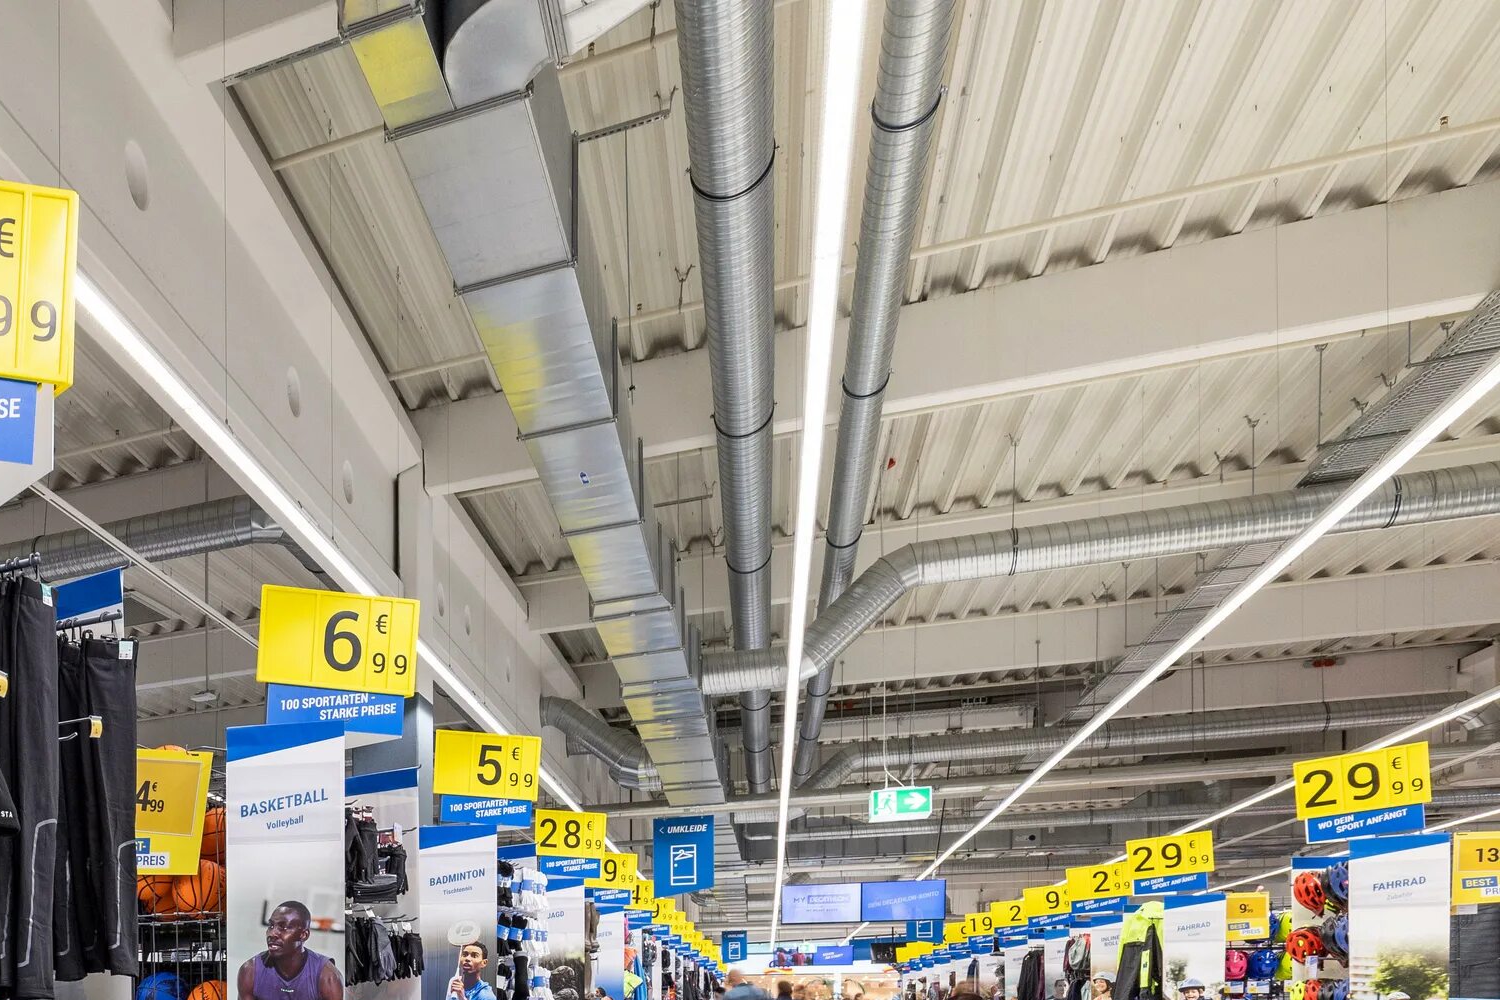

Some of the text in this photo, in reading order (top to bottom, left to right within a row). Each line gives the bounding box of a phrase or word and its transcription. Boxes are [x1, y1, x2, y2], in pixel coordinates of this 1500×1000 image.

[324, 610, 362, 672] 6
[281, 699, 300, 711] 100
[302, 693, 368, 708] SPORTARTEN
[320, 703, 396, 720] STARKE PREISE
[477, 745, 502, 786] 5
[240, 788, 328, 818] BASKETBALL
[450, 799, 508, 812] 100 SPORTARTEN
[475, 805, 527, 818] STARKE PREISE
[266, 815, 304, 830] Volleyball
[667, 824, 708, 834] UMKLEIDE
[1318, 814, 1354, 830] WO DEIN
[1336, 808, 1407, 834] SPORT ANFÄNGT
[540, 818, 580, 848] 28
[137, 856, 165, 866] PREIS
[429, 868, 485, 887] BADMINTON
[604, 859, 617, 882] 9
[1151, 877, 1164, 885] DEIN
[1152, 881, 1170, 890] SPORT
[1372, 876, 1426, 892] FAHRRAD
[1466, 878, 1494, 887] BEST-
[1177, 921, 1210, 932] FAHRRAD
